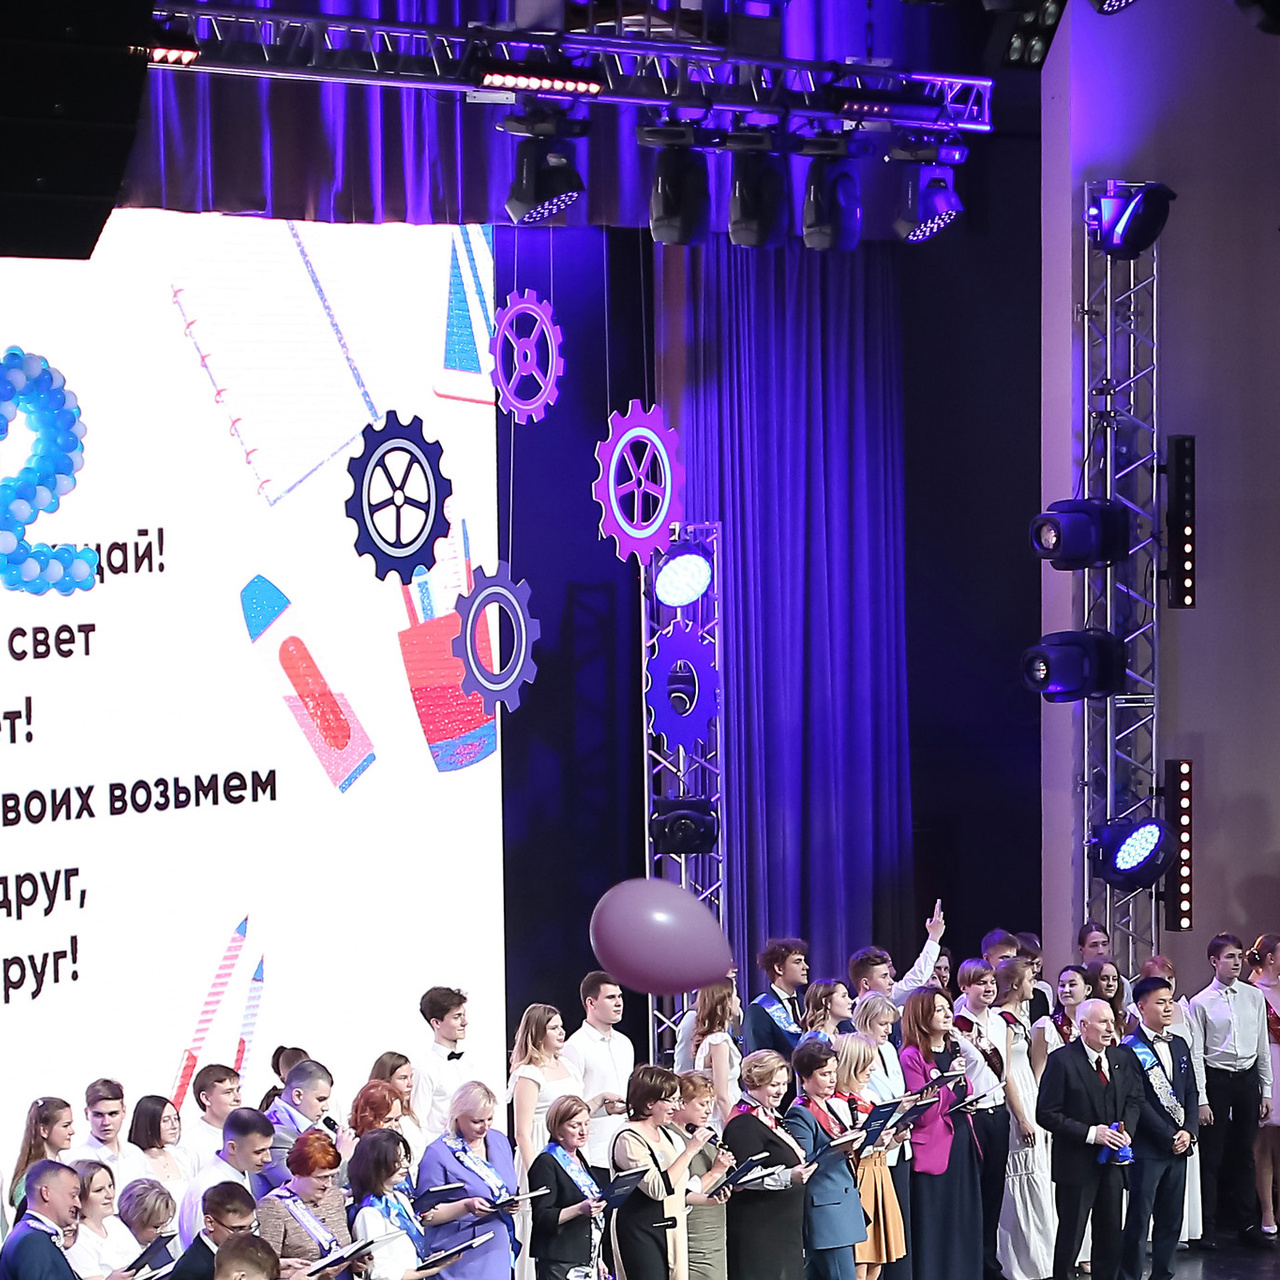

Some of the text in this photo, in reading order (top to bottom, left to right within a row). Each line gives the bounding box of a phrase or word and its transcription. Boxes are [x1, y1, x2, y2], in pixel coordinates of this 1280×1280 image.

[8, 623, 96, 661] свет
[0, 696, 33, 744] т!
[109, 769, 277, 816] возьмем
